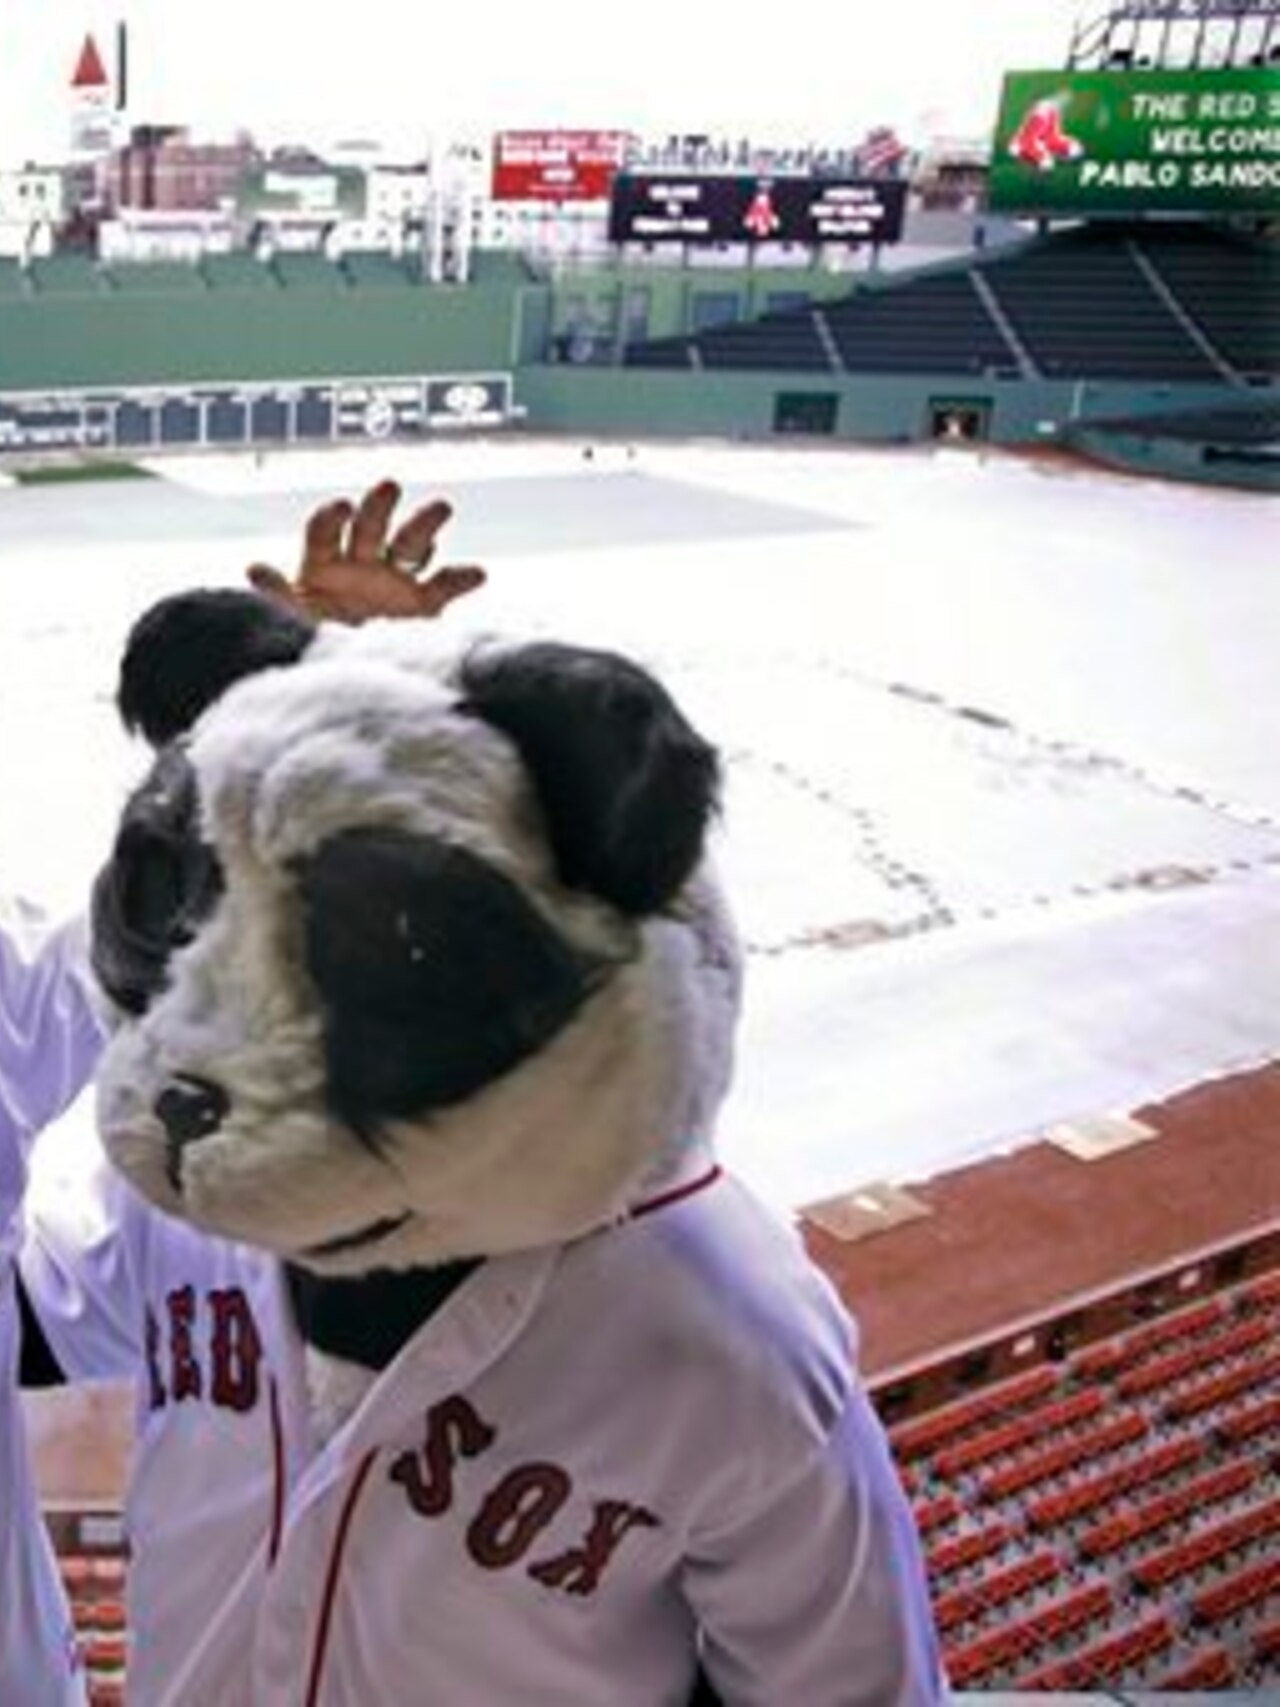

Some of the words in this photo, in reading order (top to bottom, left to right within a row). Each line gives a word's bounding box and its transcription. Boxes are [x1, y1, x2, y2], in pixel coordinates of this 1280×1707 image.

[1132, 93, 1187, 120] THE
[1199, 92, 1256, 120] RED
[1078, 161, 1181, 187] PABLO
[389, 1394, 661, 1596] SOX
